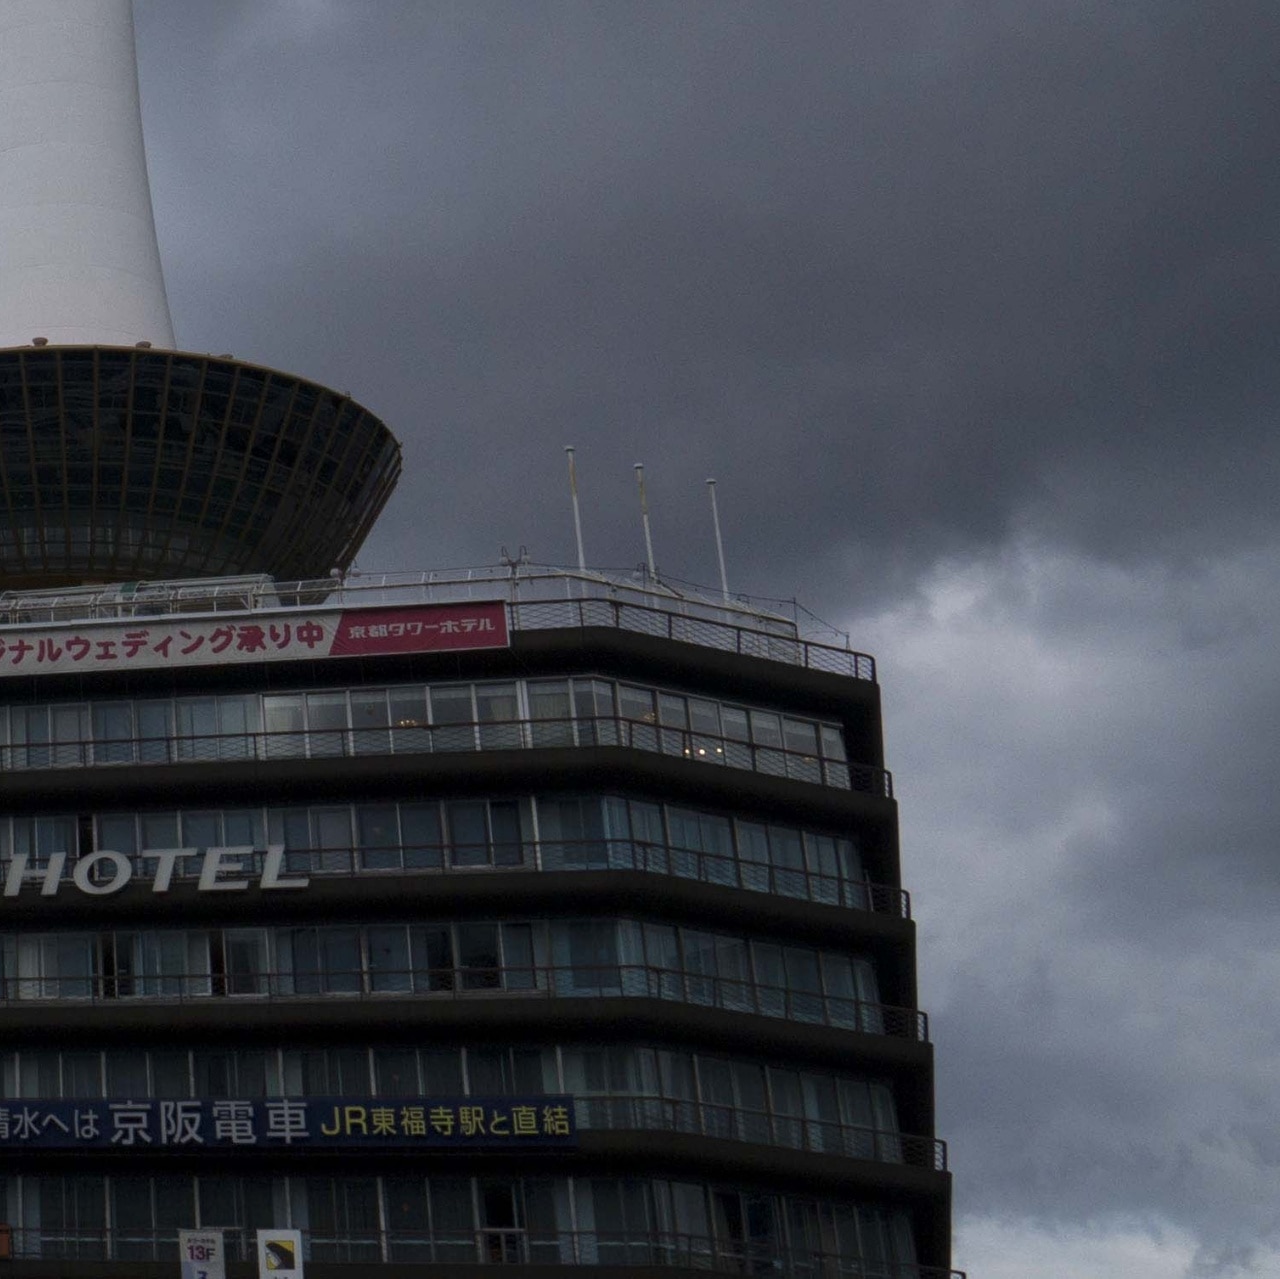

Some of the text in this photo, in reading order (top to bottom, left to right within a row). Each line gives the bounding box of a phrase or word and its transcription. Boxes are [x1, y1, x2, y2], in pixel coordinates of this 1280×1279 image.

[348, 618, 495, 639] 京都タワーホテル
[3, 844, 312, 897] HOTEL
[109, 1100, 310, 1145] 京阪電車
[321, 1106, 569, 1136] JR東福寺駅と直結
[187, 1245, 216, 1261] 13F
